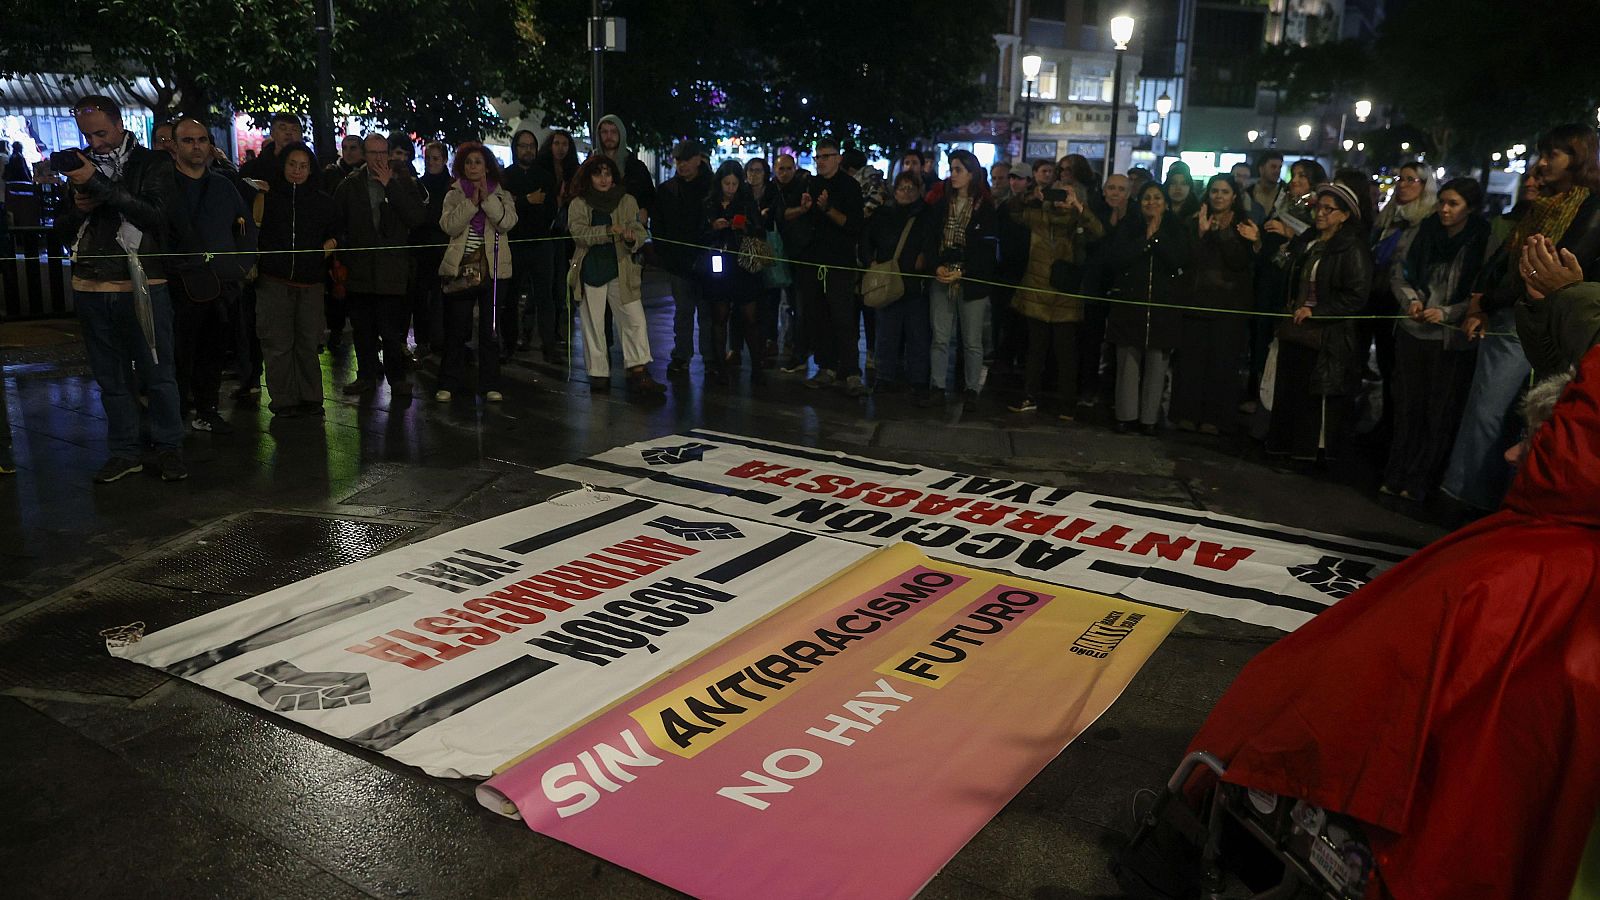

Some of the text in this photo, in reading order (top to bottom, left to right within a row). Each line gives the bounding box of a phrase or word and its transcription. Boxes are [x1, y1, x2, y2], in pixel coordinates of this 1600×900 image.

[725, 460, 1254, 571] ANTIRRACISTA
[772, 500, 1086, 574] ACCIÓN
[926, 472, 1081, 507] ¡YA!
[345, 535, 700, 671] ANTIRRACISTA
[396, 549, 524, 594] ¡YA!
[524, 577, 738, 667] ACCIÓN
[540, 572, 954, 819] SIN ANTIRRACISMO
[716, 591, 1039, 811] NO HAY FUTURO
